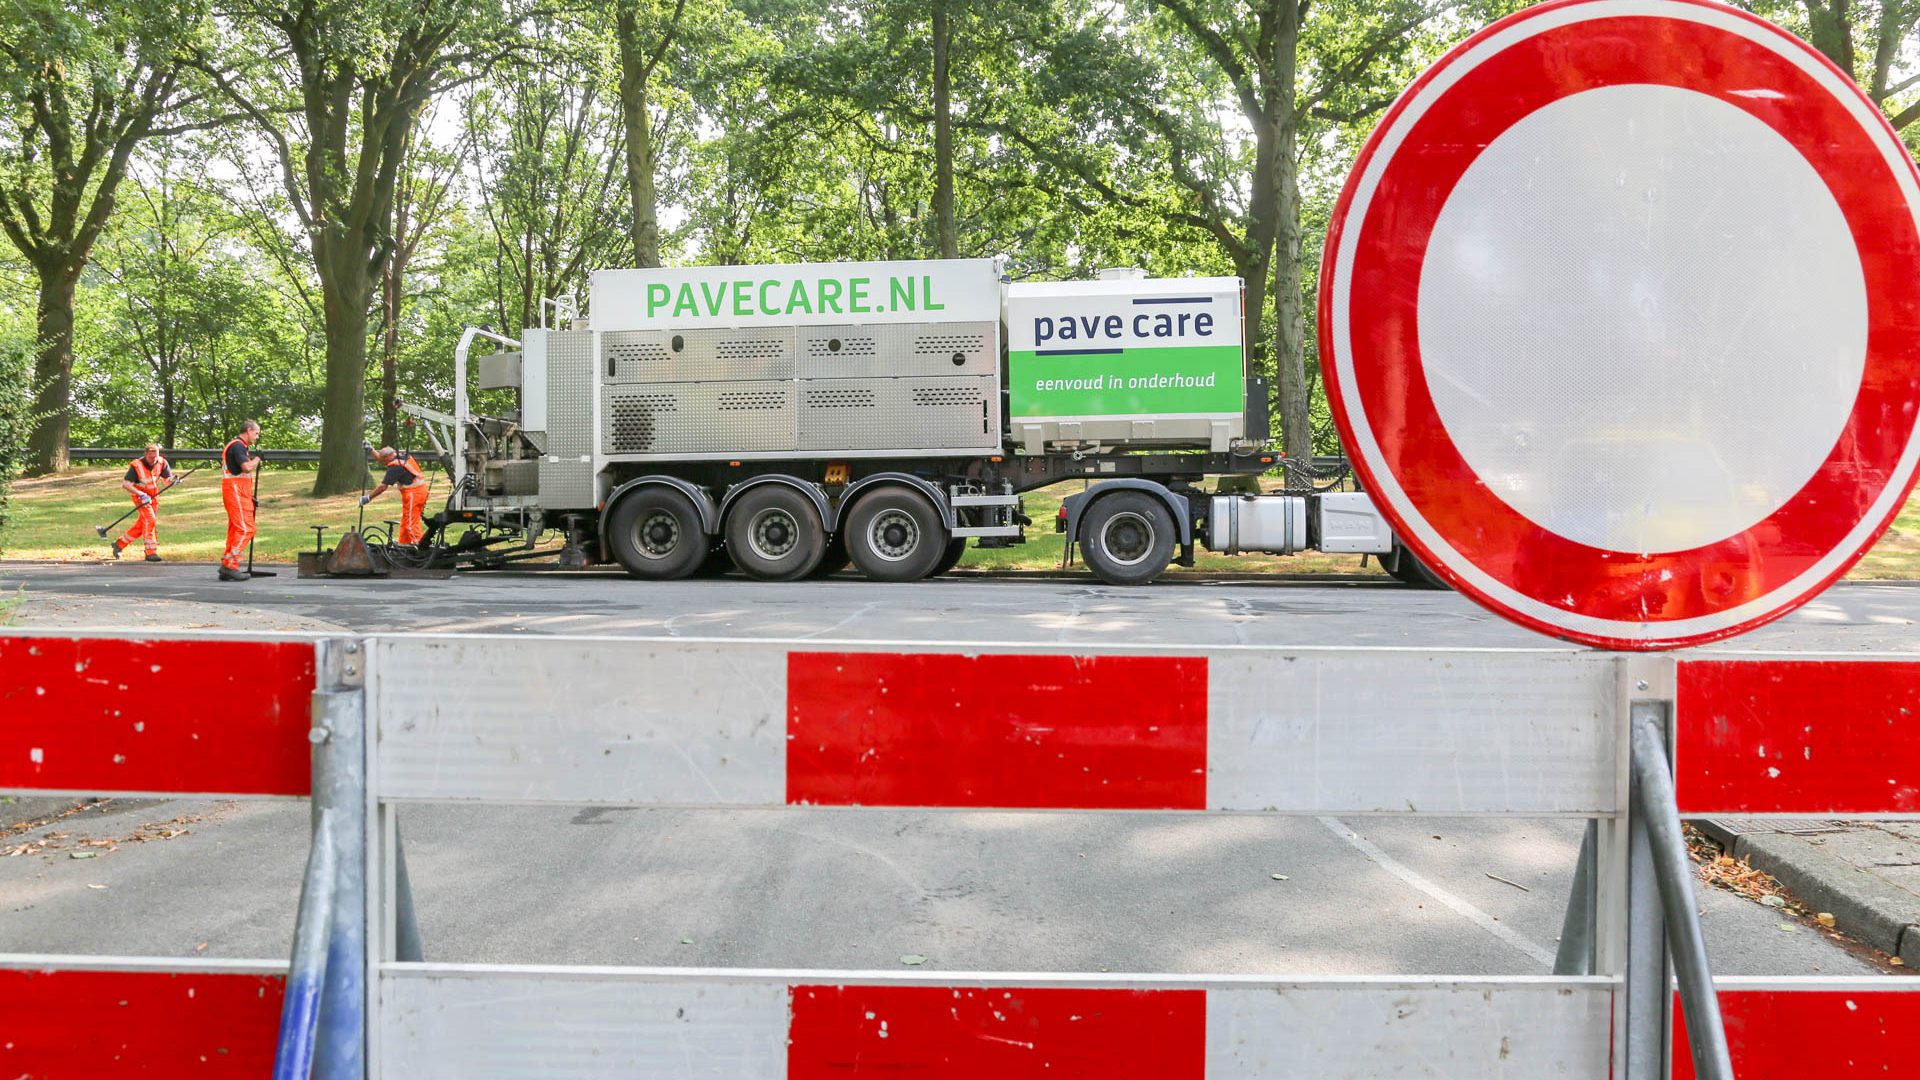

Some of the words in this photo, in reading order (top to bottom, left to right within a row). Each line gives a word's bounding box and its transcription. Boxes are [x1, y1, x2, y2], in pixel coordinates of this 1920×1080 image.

[646, 275, 946, 319] PAVECARE.NL
[1034, 315, 1123, 347] pave
[1132, 312, 1214, 338] care
[1035, 374, 1104, 391] eenvoud
[1108, 374, 1123, 389] in
[1128, 371, 1216, 389] onderhoud
